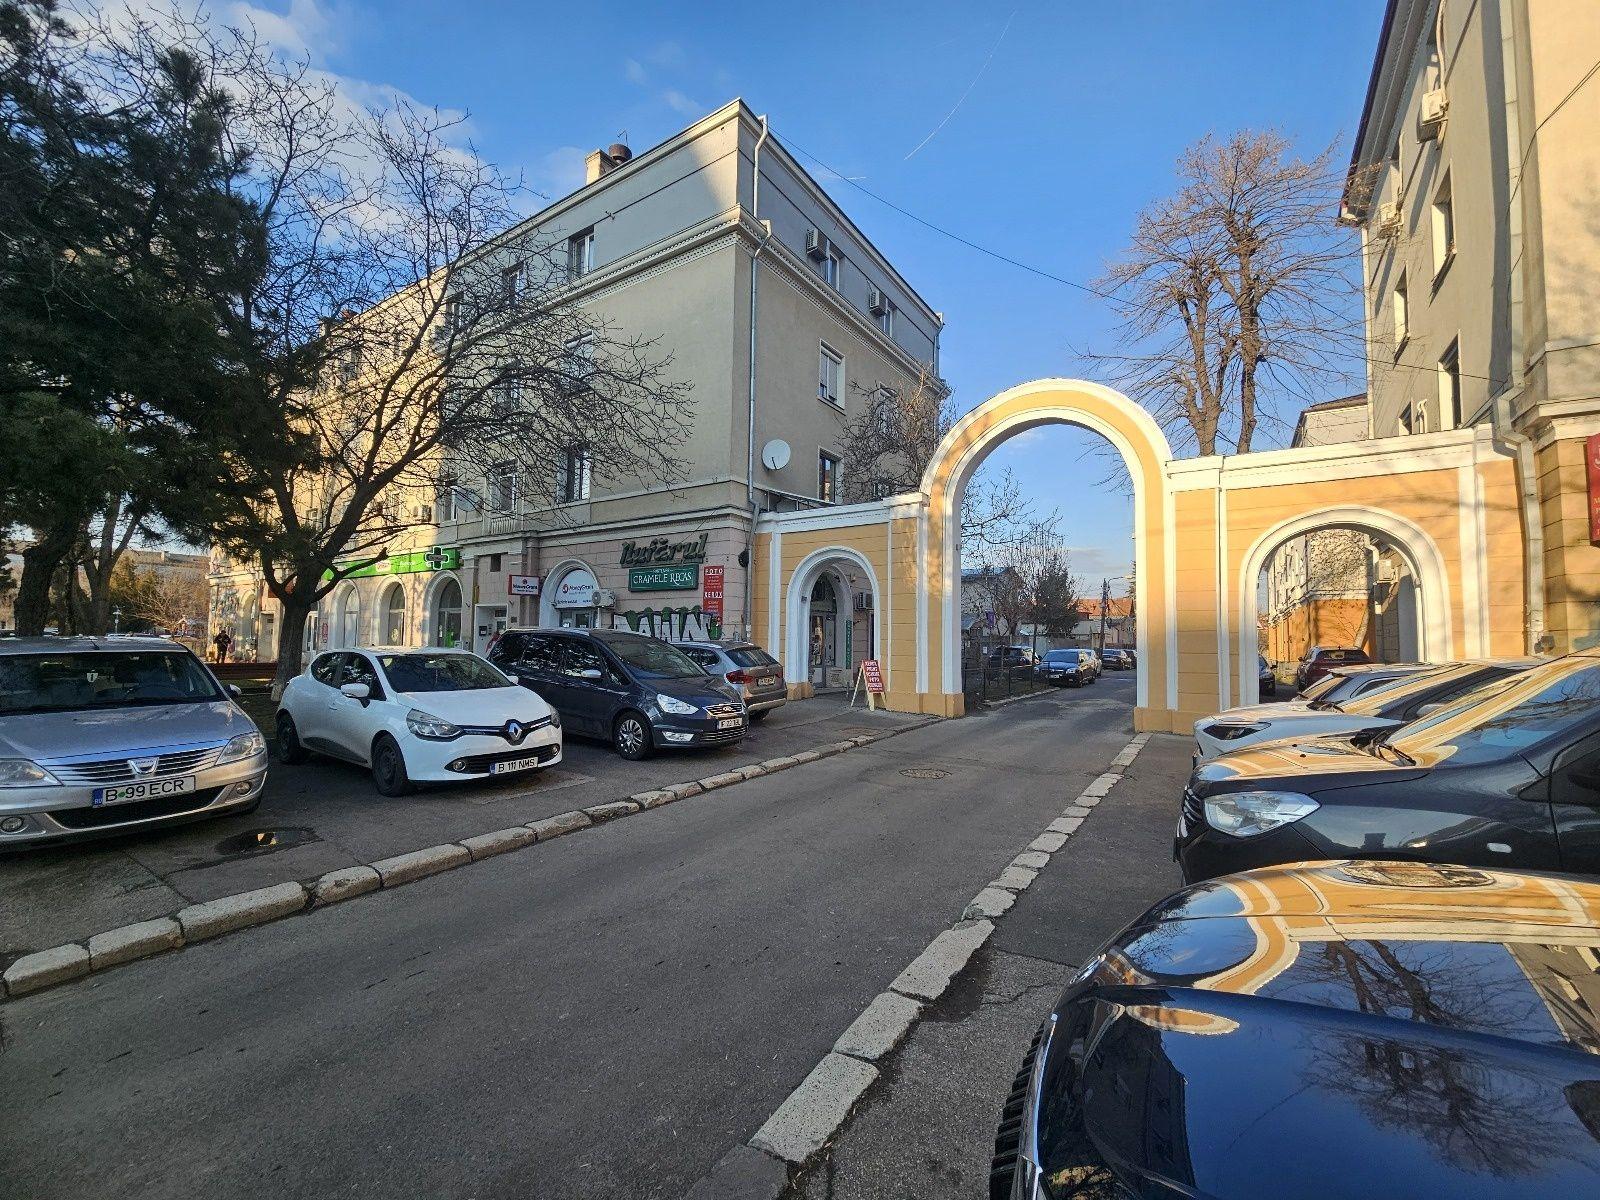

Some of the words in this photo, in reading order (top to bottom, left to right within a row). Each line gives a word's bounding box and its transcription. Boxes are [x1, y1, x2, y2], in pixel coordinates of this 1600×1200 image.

[633, 573, 668, 584] CRAMELE
[704, 591, 723, 599] XEROX
[498, 763, 505, 773] B
[507, 761, 517, 771] 111
[105, 789, 118, 802] B
[125, 785, 146, 799] 99
[149, 779, 185, 795] ECR
